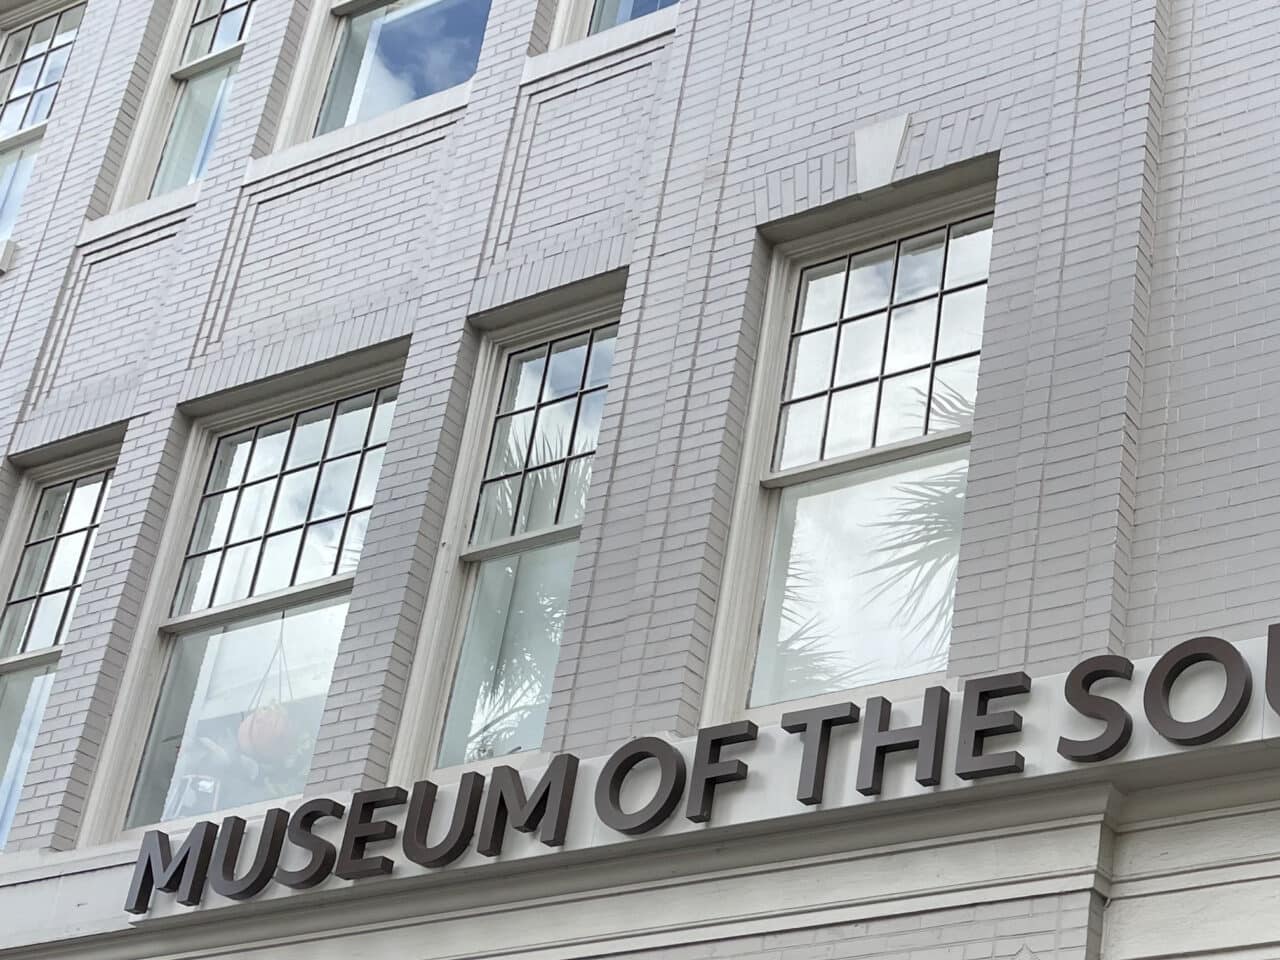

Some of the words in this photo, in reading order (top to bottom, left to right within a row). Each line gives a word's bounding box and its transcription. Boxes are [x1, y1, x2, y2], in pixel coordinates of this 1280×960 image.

[124, 753, 580, 914] MUSEUM
[594, 720, 759, 836] OF
[781, 671, 1031, 805] THE
